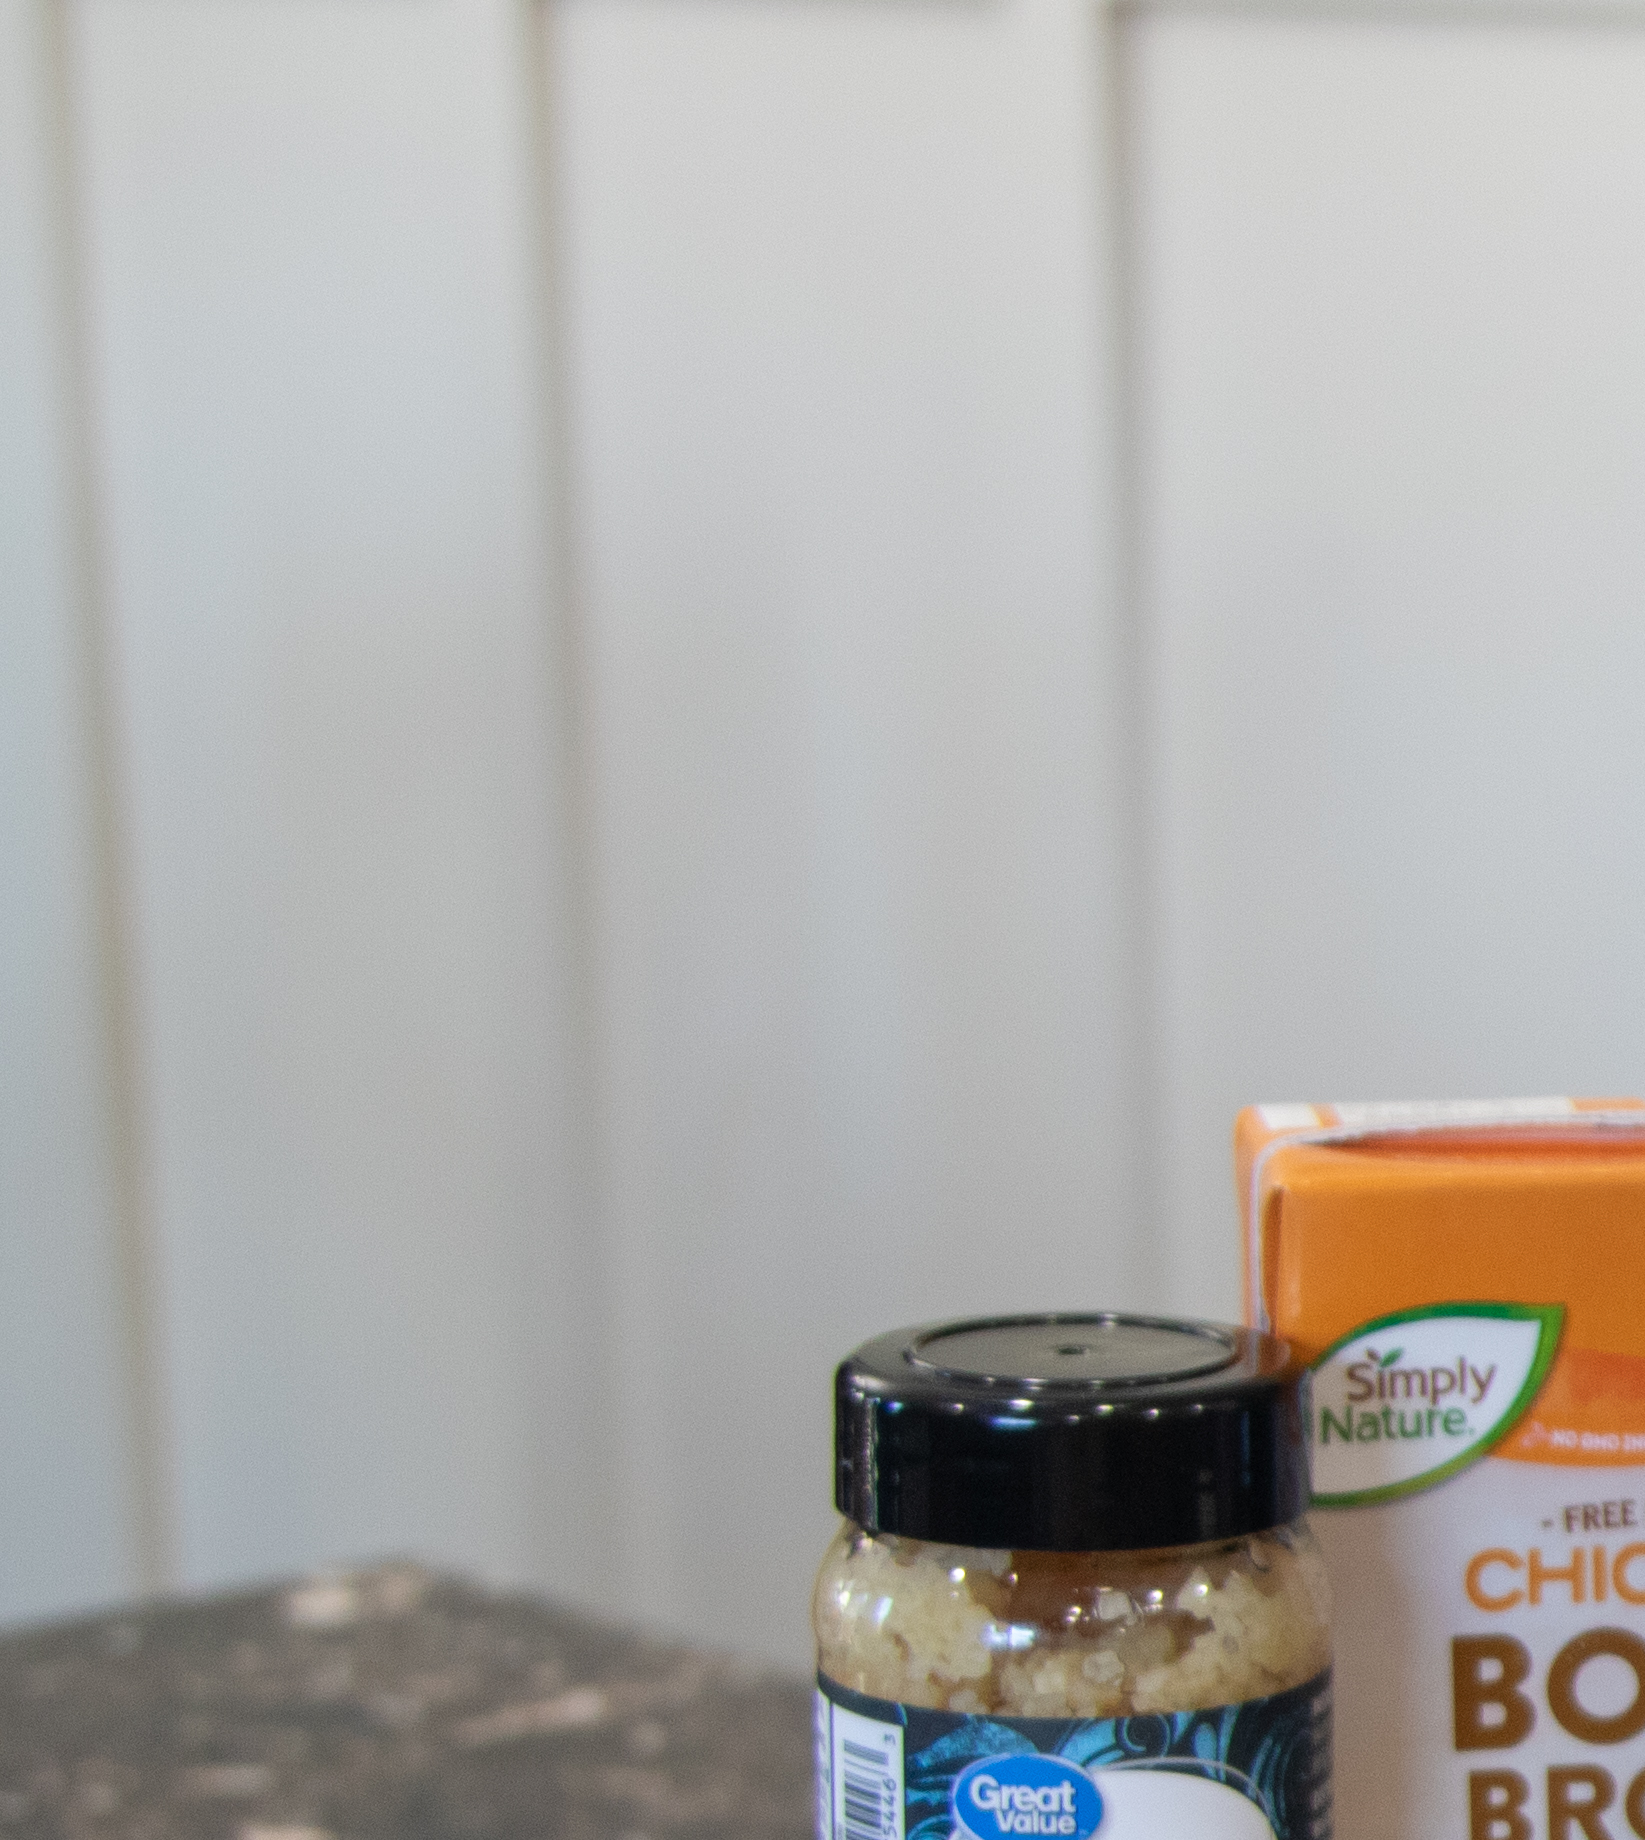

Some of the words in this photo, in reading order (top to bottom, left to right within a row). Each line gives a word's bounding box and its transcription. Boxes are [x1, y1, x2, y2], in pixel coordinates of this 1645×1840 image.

[1346, 1356, 1498, 1409] Simply
[1564, 1500, 1636, 1533] FREE
[969, 1772, 1077, 1814] Great
[995, 1807, 1077, 1837] Value
